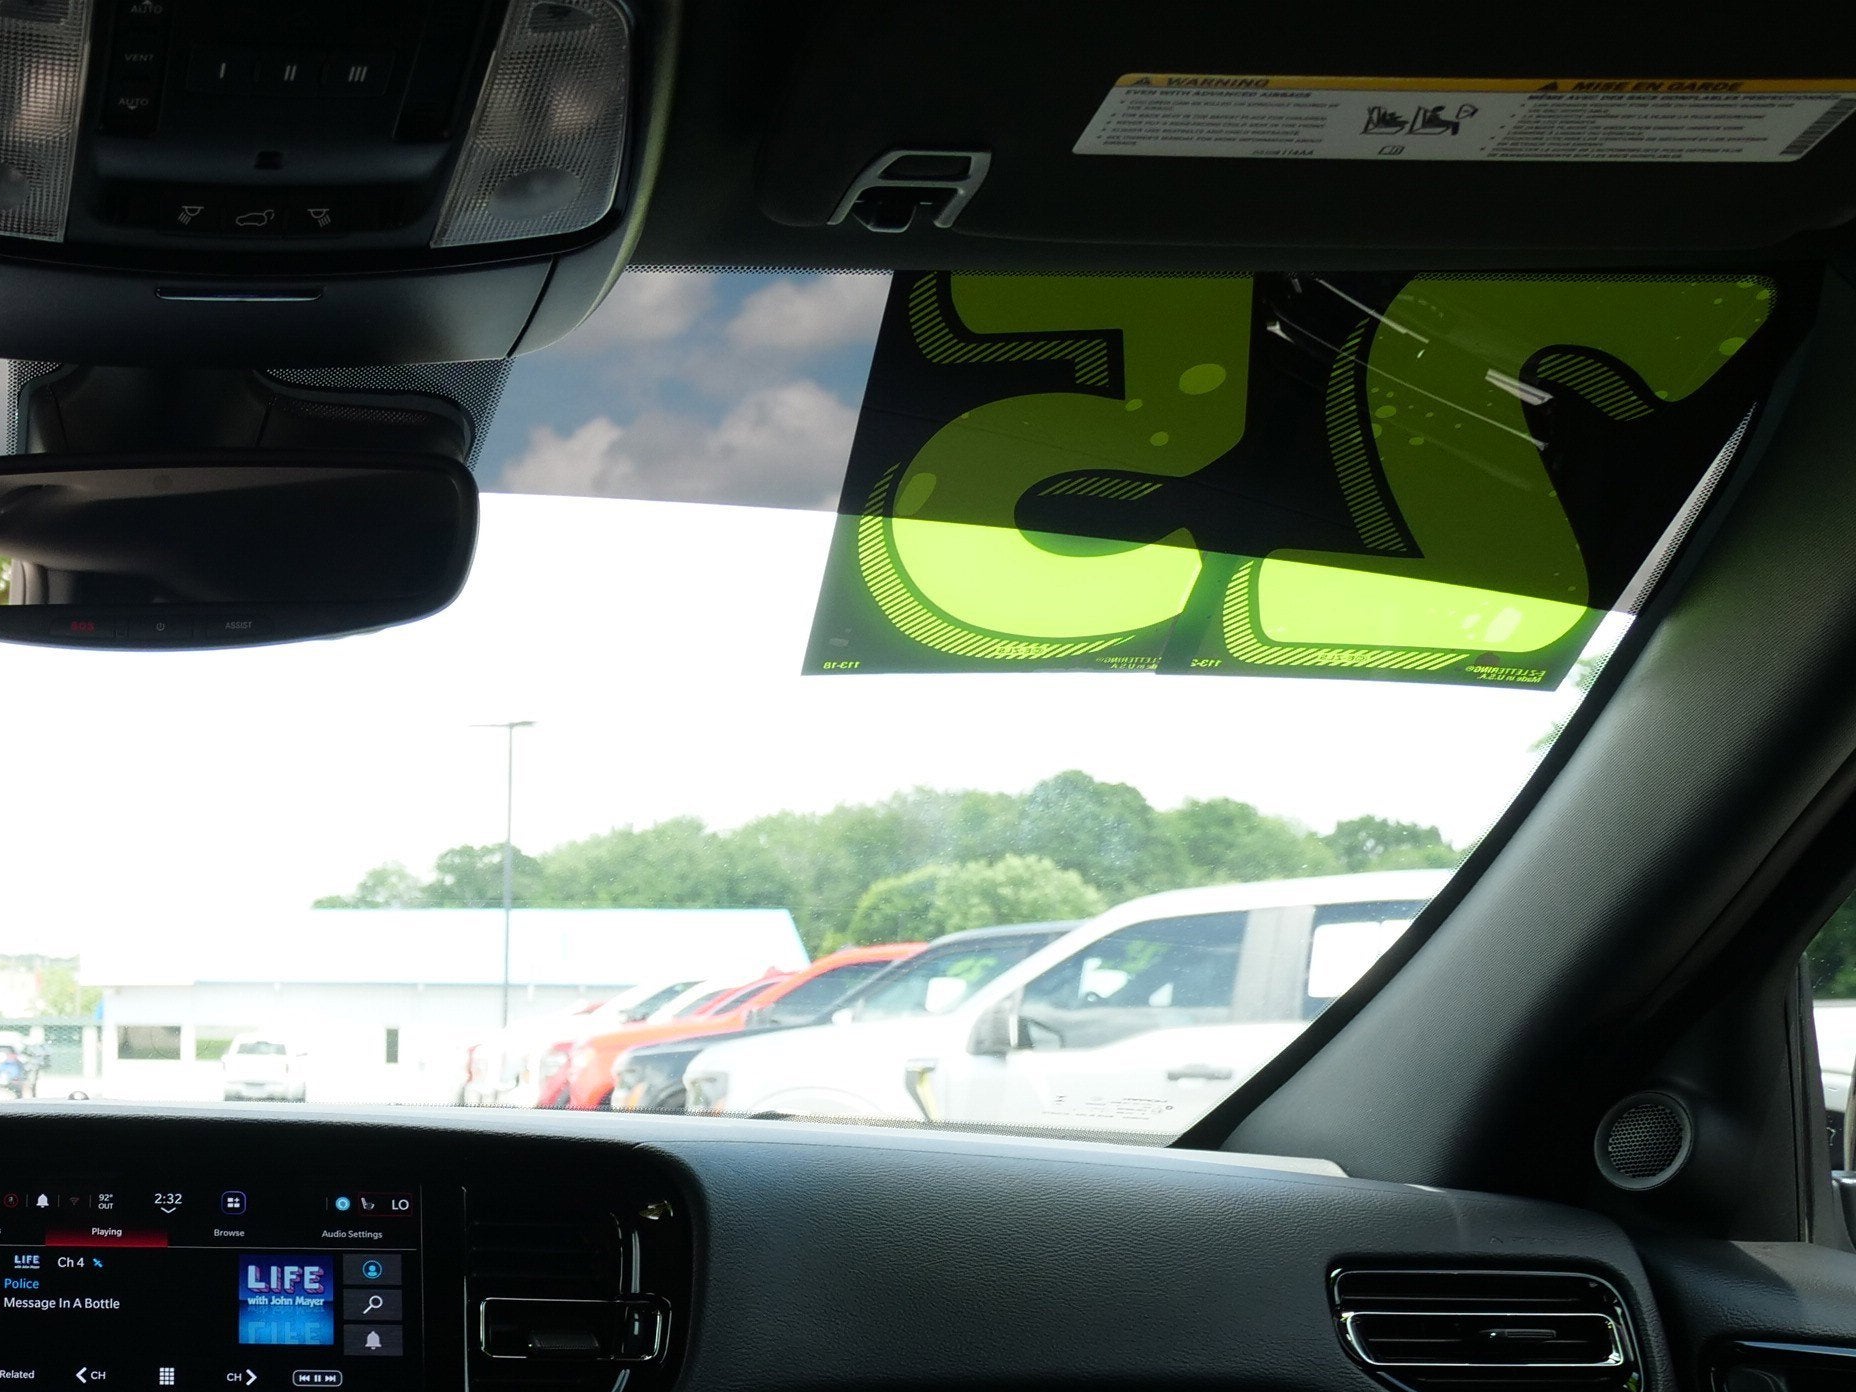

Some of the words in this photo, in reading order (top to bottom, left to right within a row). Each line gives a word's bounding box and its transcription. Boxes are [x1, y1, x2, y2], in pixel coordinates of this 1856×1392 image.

[124, 53, 154, 61] VENT
[1166, 77, 1270, 88] WARNING
[1573, 82, 1628, 92] MISE
[1631, 82, 1662, 92] EN
[1666, 82, 1745, 92] GARDE
[1192, 90, 1258, 98] ADVANCED
[225, 621, 253, 629] ASSIST
[98, 1193, 114, 1202] 92°
[154, 1193, 183, 1205] 2:32
[98, 1202, 114, 1210] OUT
[391, 1199, 410, 1211] LO
[91, 1227, 123, 1237] Playing
[214, 1229, 245, 1237] Browse
[321, 1229, 347, 1239] Audio
[348, 1230, 383, 1240] Settings
[14, 1255, 41, 1264] LIFE
[57, 1256, 75, 1268] Ch
[77, 1257, 85, 1267] 4
[4, 1278, 40, 1290] Police
[247, 1265, 324, 1293] LIFE
[4, 1297, 56, 1311] Message
[59, 1298, 71, 1308] In
[72, 1298, 82, 1309] A
[84, 1298, 120, 1310] Bottle
[247, 1296, 269, 1306] with
[270, 1296, 294, 1306] John
[295, 1296, 325, 1308] Mayer
[0, 1369, 35, 1379] Related
[90, 1371, 106, 1380] CH
[226, 1372, 242, 1382] CH
